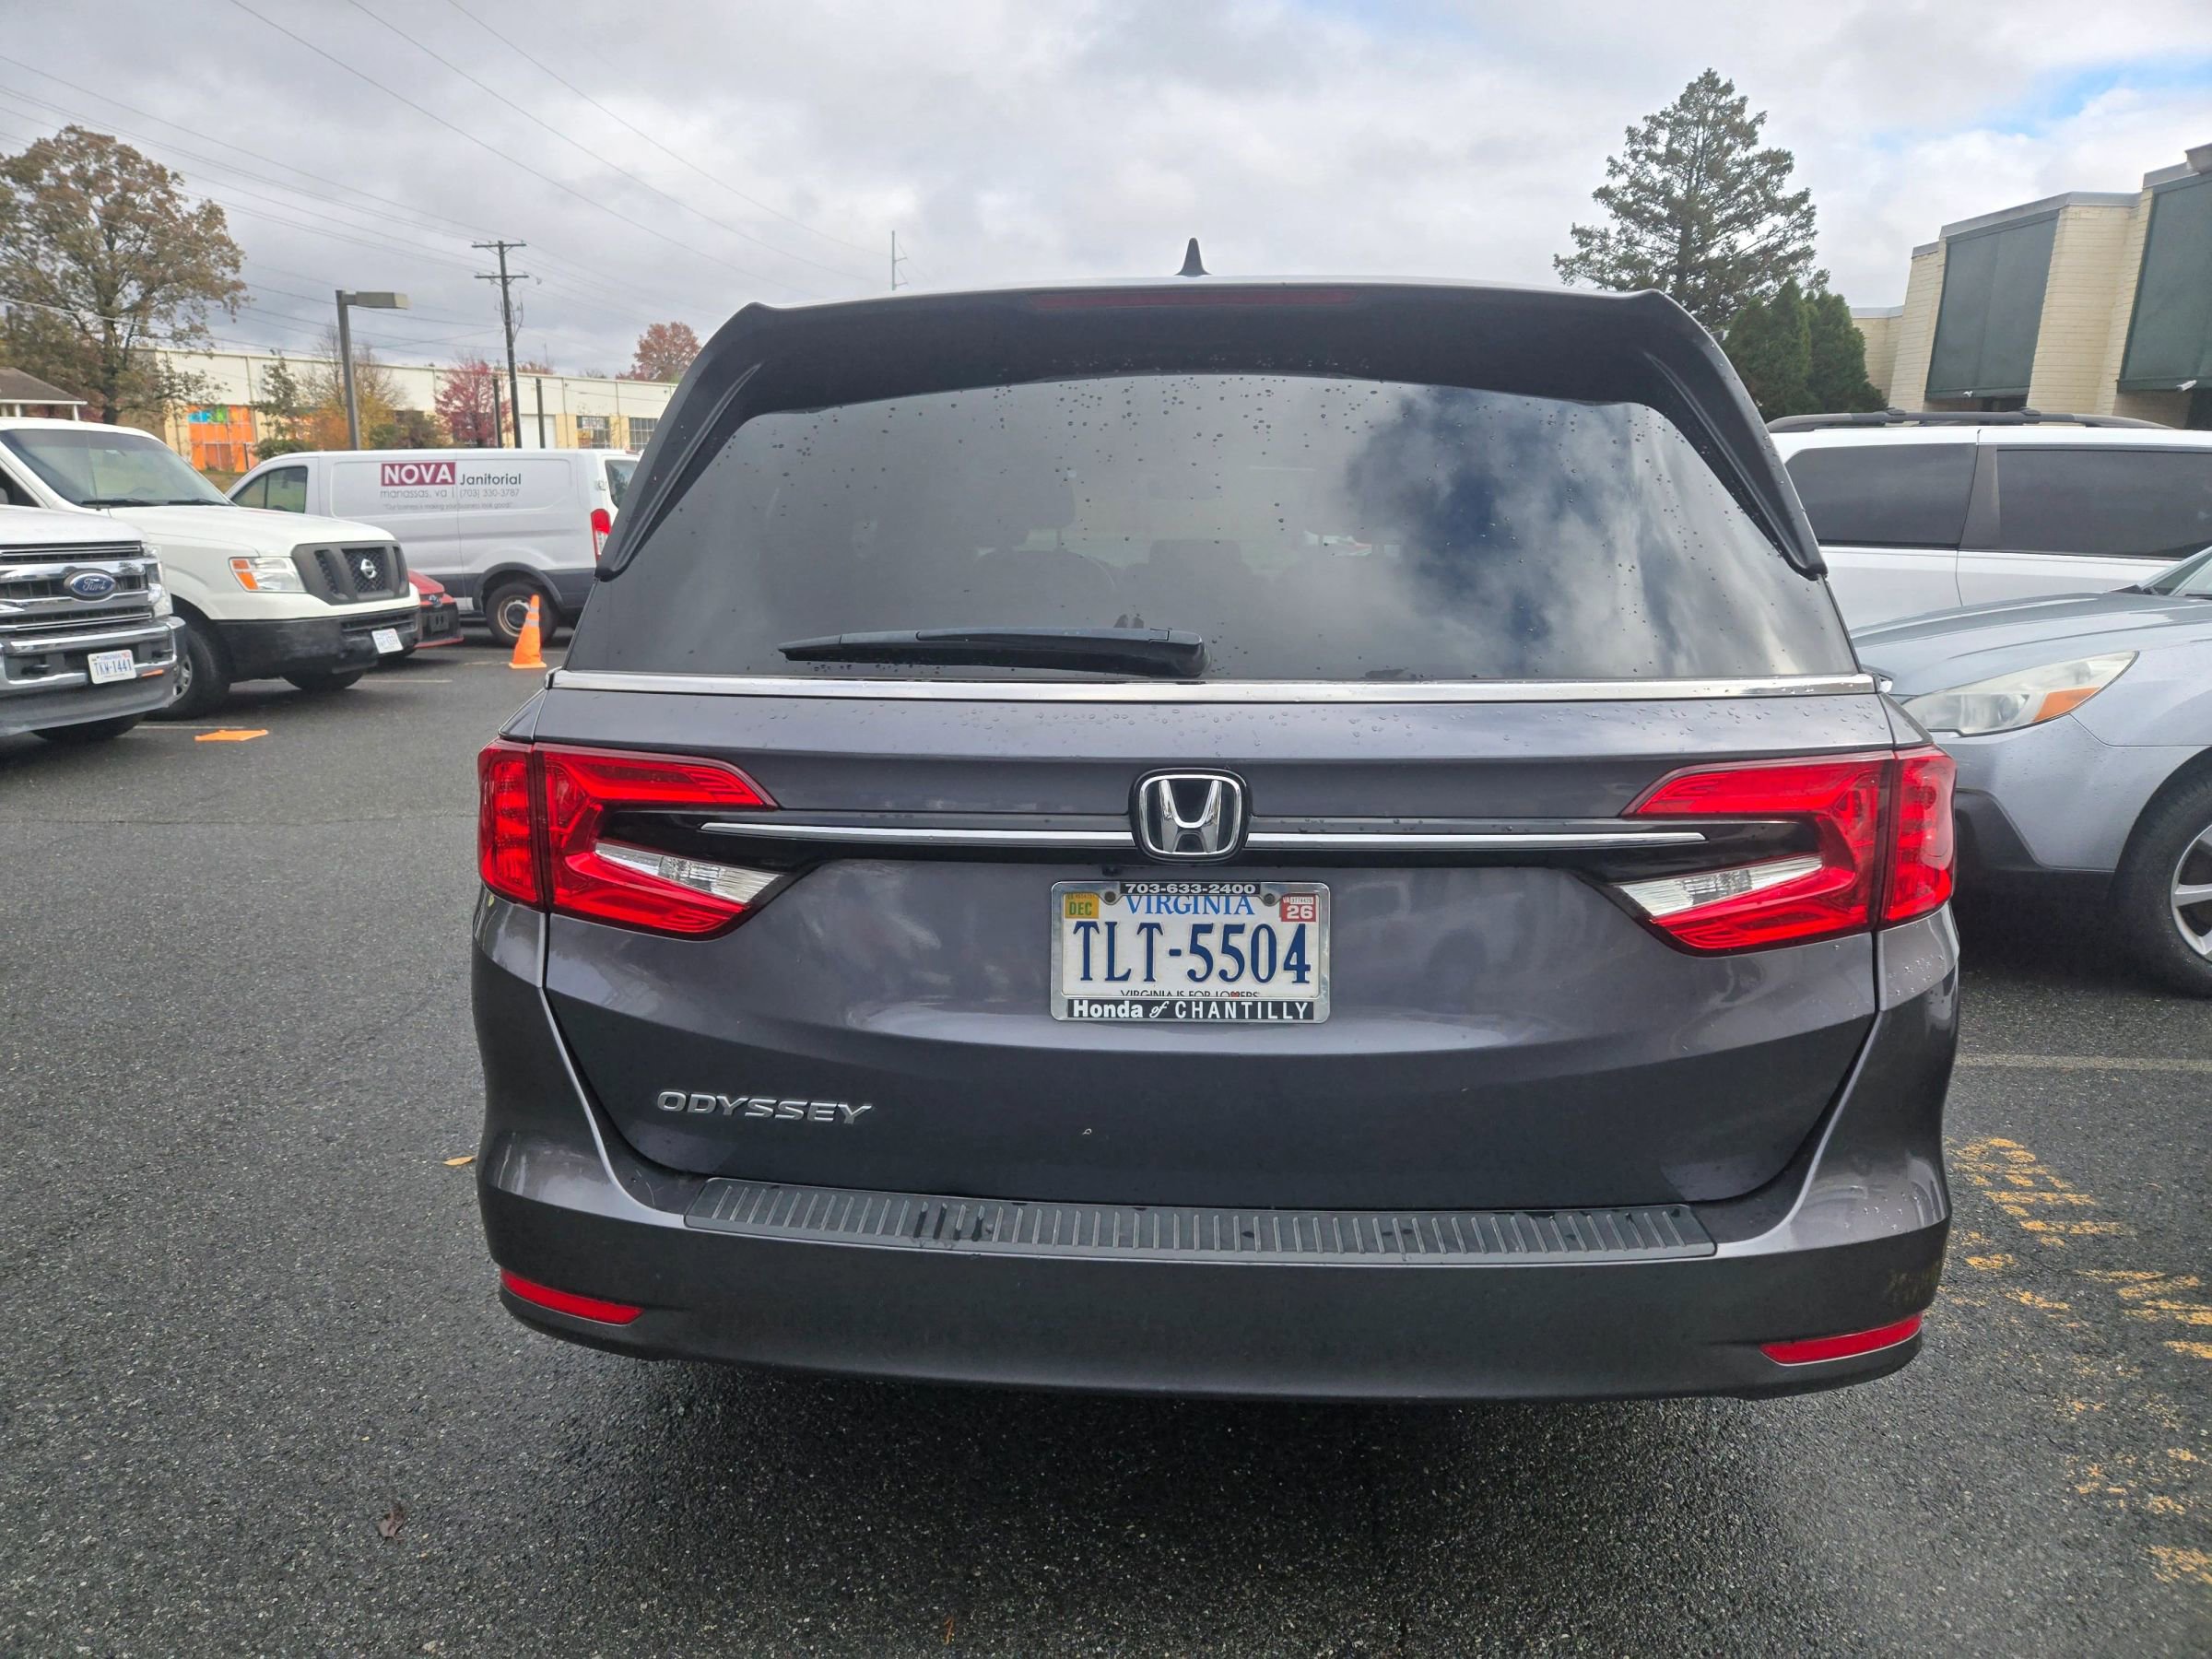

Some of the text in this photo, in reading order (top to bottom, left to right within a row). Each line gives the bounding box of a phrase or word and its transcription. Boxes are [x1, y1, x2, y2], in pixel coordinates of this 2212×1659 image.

[383, 464, 522, 486] NOVA Janitorial
[483, 488, 520, 498] 330-3787
[82, 578, 107, 592] Ford
[1124, 883, 1256, 894] 703-633-2400
[1069, 901, 1092, 916] DEC
[1125, 895, 1256, 915] VIRGINIA
[1286, 904, 1313, 920] 26
[1073, 921, 1312, 984] TLT-5504
[1073, 1000, 1309, 1020] Honda of CHANTILLY
[656, 1090, 873, 1124] ODYSSEY
